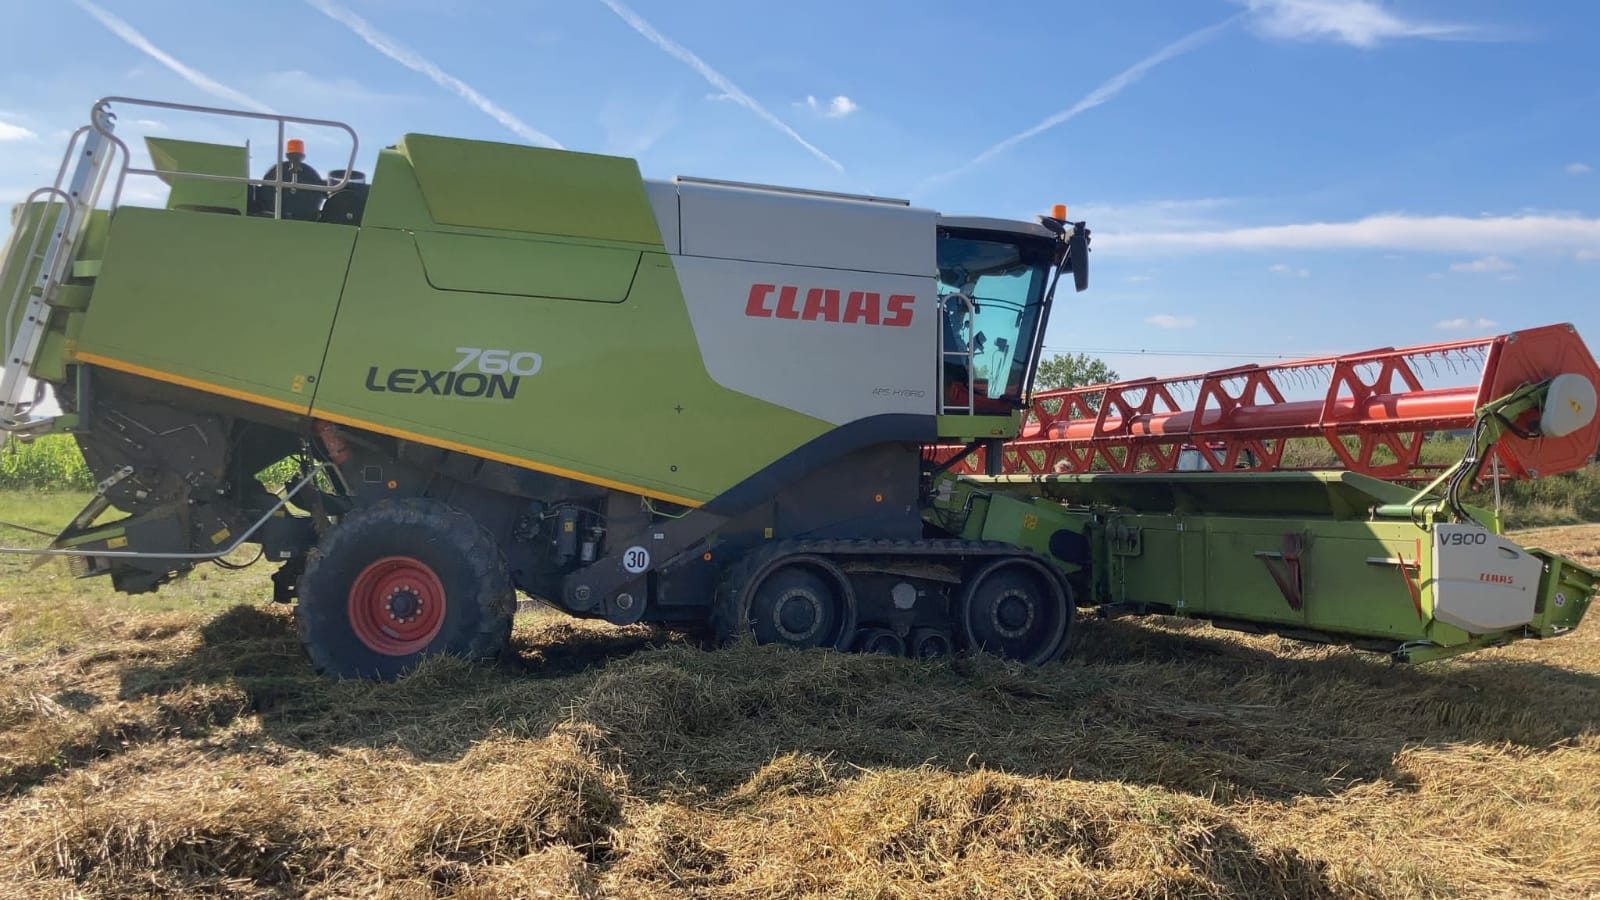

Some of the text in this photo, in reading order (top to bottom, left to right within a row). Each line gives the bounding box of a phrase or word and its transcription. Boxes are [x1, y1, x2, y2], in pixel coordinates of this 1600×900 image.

[745, 284, 916, 327] CLAAS
[451, 347, 542, 376] 760
[365, 366, 520, 399] LEXION
[1440, 533, 1486, 545] V900
[627, 551, 645, 568] 30
[1480, 573, 1513, 584] CLAAS
